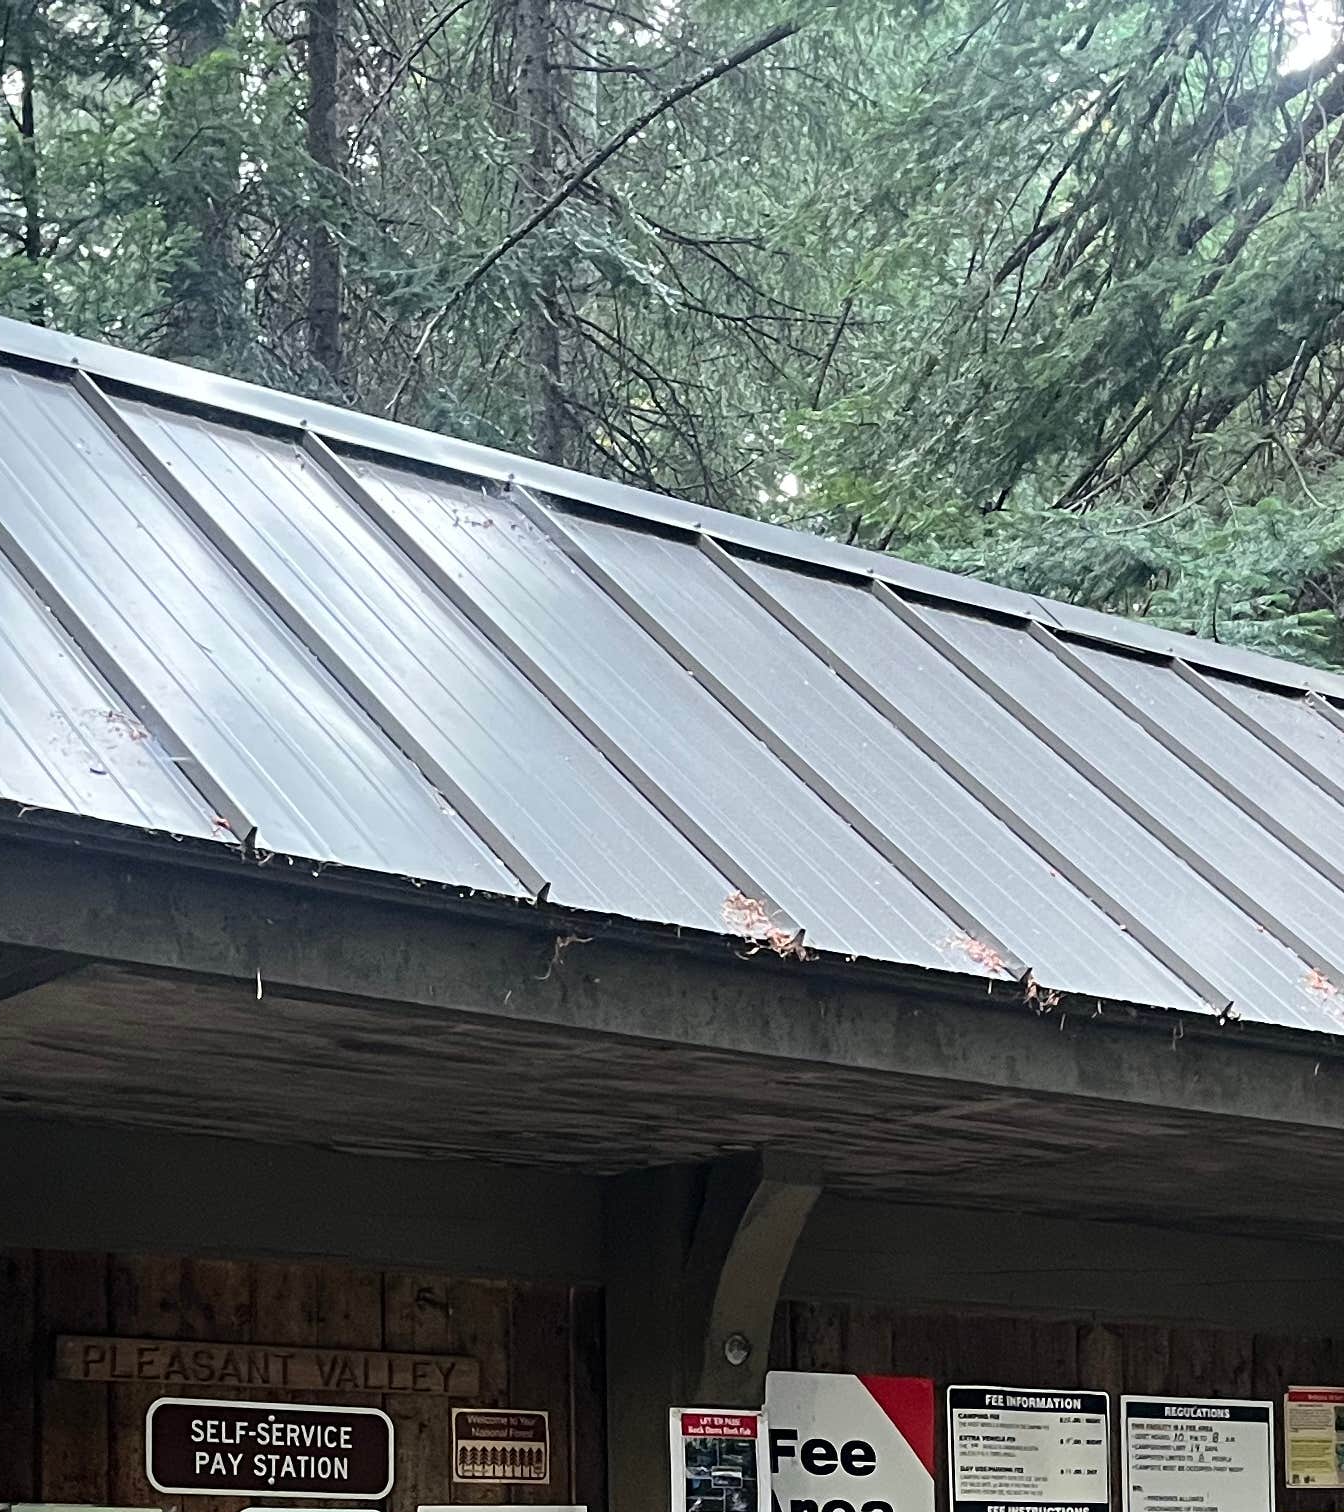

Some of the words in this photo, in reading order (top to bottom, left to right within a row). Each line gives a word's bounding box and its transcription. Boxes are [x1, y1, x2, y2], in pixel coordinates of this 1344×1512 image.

[82, 1344, 295, 1386] PLEASANT
[317, 1355, 456, 1393] VALLEY
[986, 1394, 1004, 1406] FEE
[1006, 1396, 1081, 1409] INFORMATION
[1165, 1407, 1230, 1418] REGULATIONS
[190, 1420, 353, 1449] SELF-SERVICE
[195, 1452, 244, 1476] PAY
[254, 1453, 348, 1480] STATION
[768, 1428, 876, 1476] Fee
